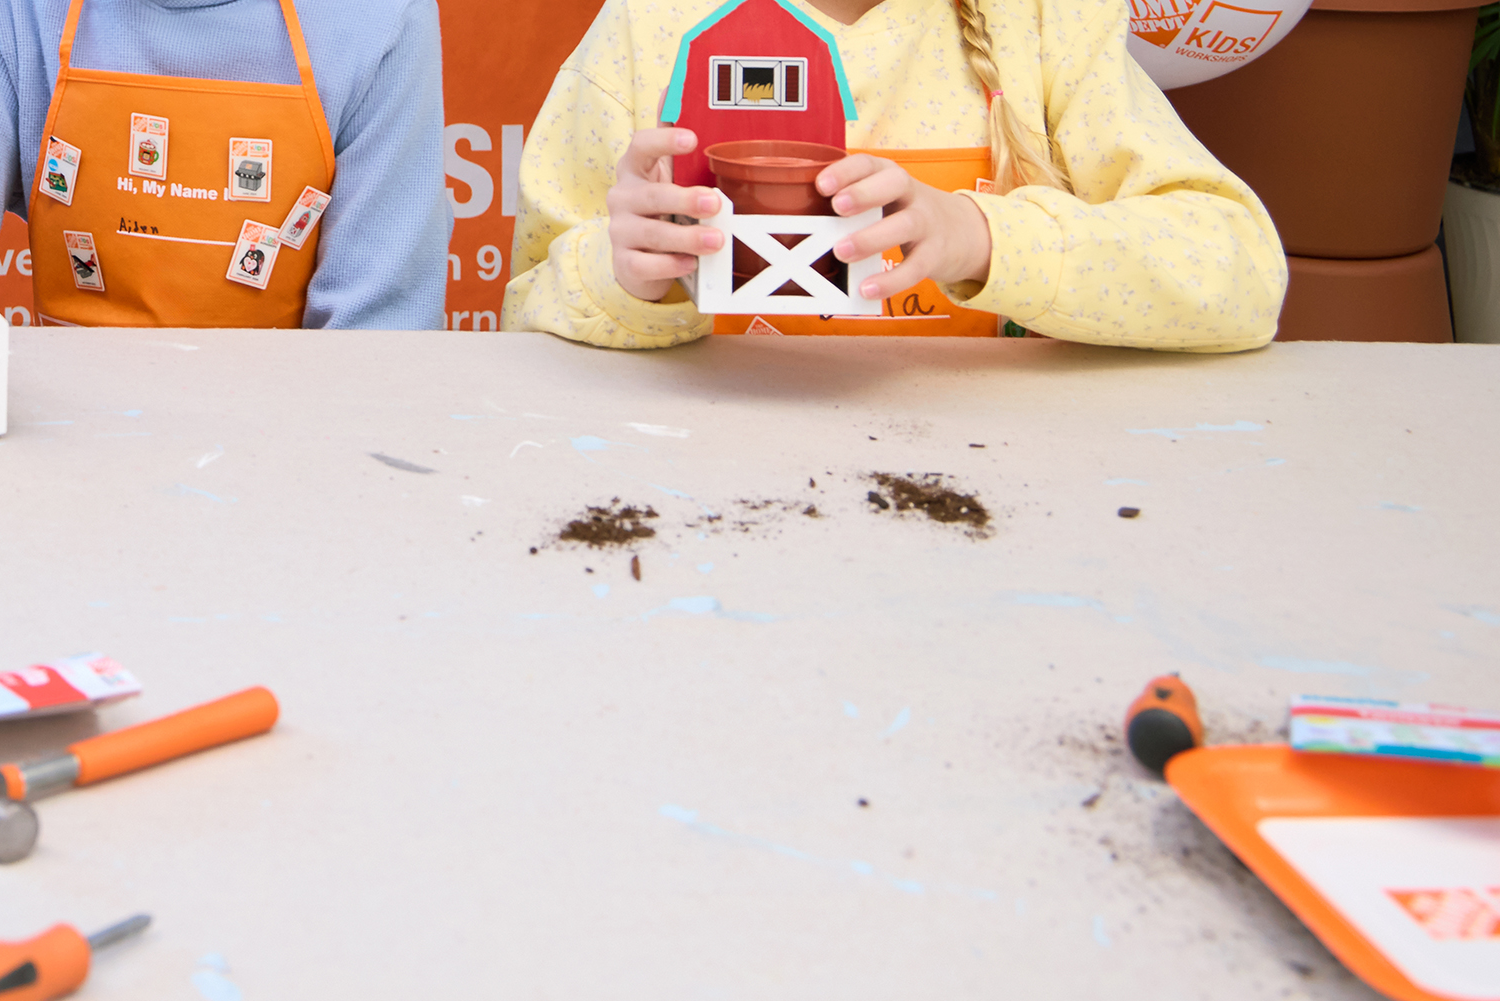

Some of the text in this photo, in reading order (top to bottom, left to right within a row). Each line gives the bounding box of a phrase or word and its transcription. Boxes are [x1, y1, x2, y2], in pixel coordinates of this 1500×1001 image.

[1184, 26, 1257, 54] KIDS
[1175, 46, 1249, 63] WORKSHOPS
[117, 176, 138, 195] Hi,
[142, 180, 166, 198] My
[170, 183, 218, 200] Name
[476, 244, 503, 281] 9
